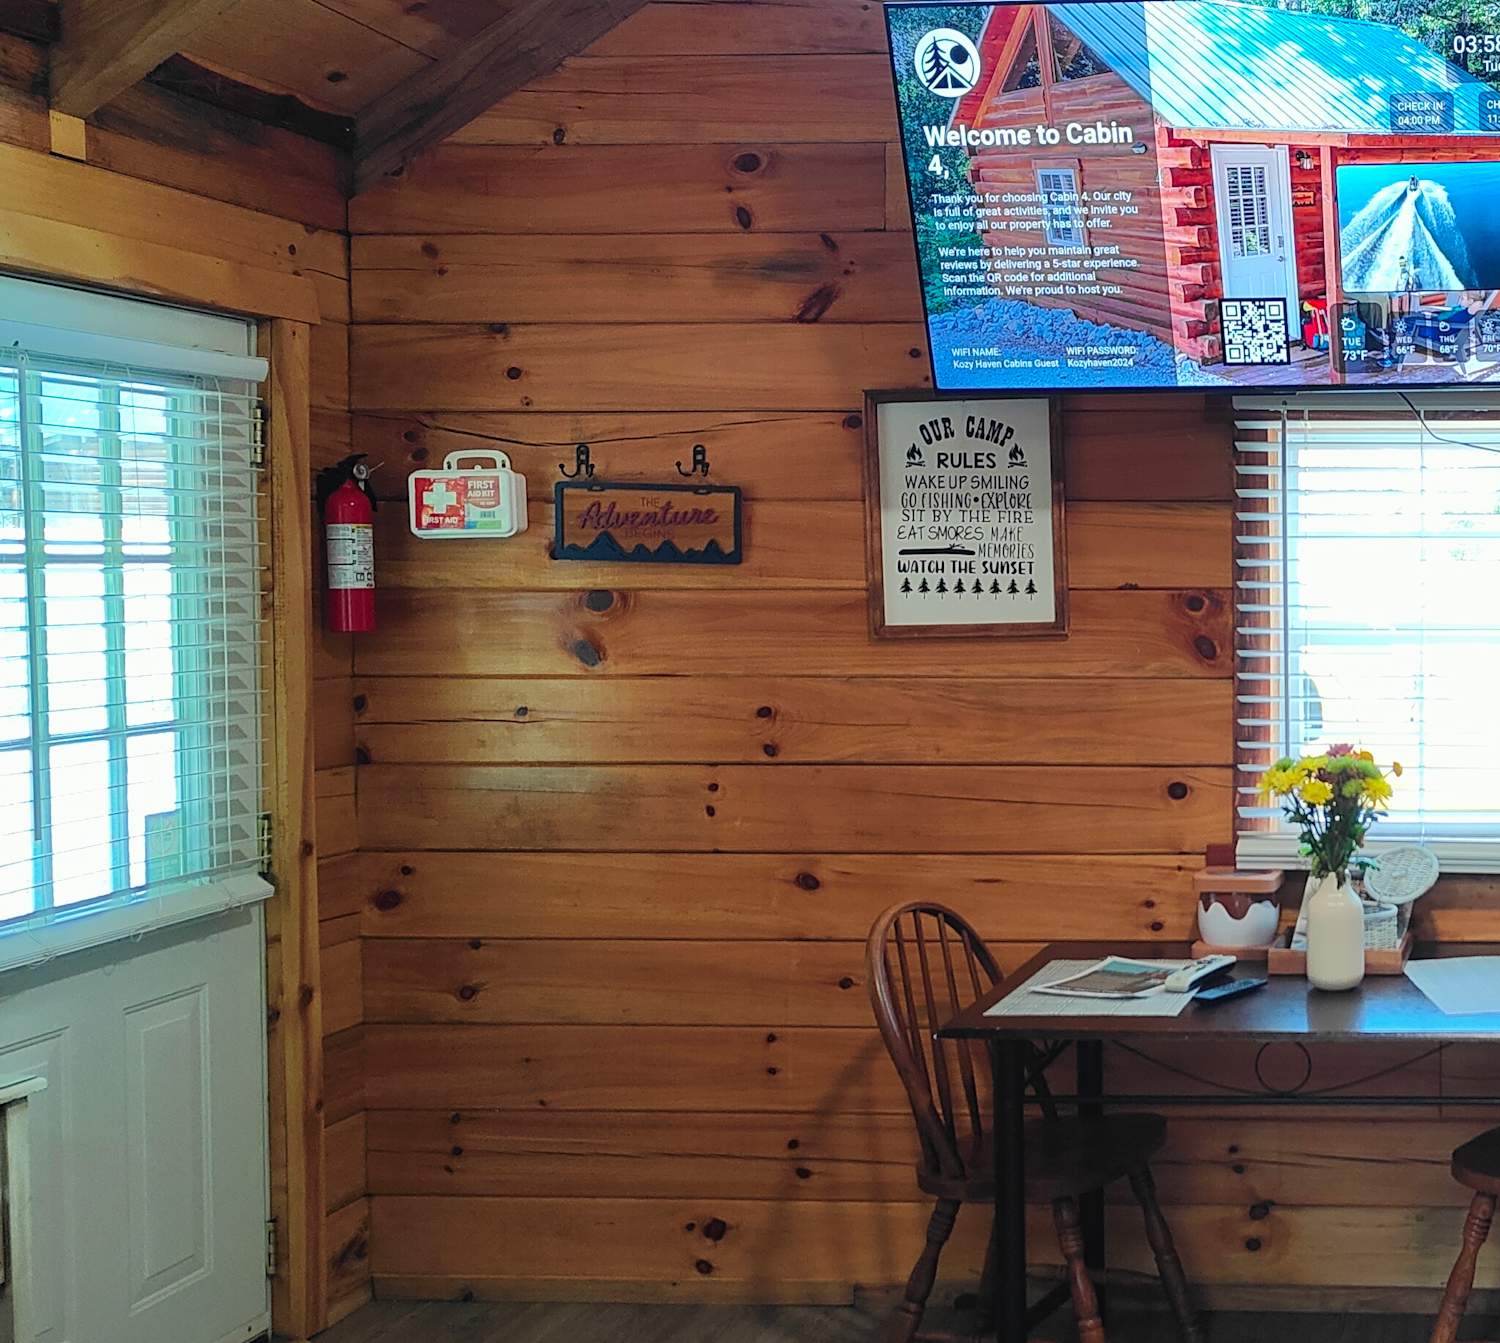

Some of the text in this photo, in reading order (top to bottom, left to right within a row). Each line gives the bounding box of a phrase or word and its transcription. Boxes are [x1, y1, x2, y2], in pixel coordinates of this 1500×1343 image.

[1397, 101, 1431, 111] CHECK
[1398, 115, 1440, 125] 04:00 PM
[923, 122, 1133, 146] Welcome to Cabin
[928, 155, 949, 179] 4,
[932, 191, 1132, 206] Thank you for choosing Cabin 4. Our city
[945, 207, 961, 217] full
[962, 207, 974, 217] of
[976, 207, 1001, 218] great
[1003, 206, 1050, 217] activities,
[1052, 205, 1071, 215] and
[1073, 206, 1089, 215] we
[1090, 205, 1117, 215] invite
[1119, 206, 1139, 217] you
[935, 218, 1112, 233] to enjoy all our property has to offer.
[938, 245, 1120, 257] We're here to help you maintain great
[940, 258, 1140, 271] reviews by delivering a 5-star experience.
[942, 271, 1096, 283] Scan the QR code for additional
[944, 284, 1124, 297] information. We're proud to host you.
[1341, 337, 1361, 346] TUE
[1395, 336, 1412, 344] WED
[951, 348, 1001, 356] WIFI NAME:
[1066, 346, 1138, 355] WIFI PASSWORD:
[1342, 350, 1368, 361] 73°F
[953, 358, 1059, 370] Kozy Haven Cabins Guest
[1068, 358, 1134, 369] Kozyhaven2024
[919, 415, 1015, 448] OUR CAMP
[937, 452, 996, 469] RULES
[467, 480, 494, 489] FIRST
[905, 475, 1029, 490] WAKE UP SMILING
[640, 497, 660, 507] THE
[901, 493, 917, 509] GO
[445, 516, 458, 524] AID
[579, 501, 719, 529] Adventure
[902, 509, 1034, 524] SIT BY THE FIRE
[897, 525, 1023, 542] EAT SMORES MAKE
[978, 543, 1034, 559] MEMORIES
[897, 560, 945, 574] WATCH
[952, 560, 976, 574] THE
